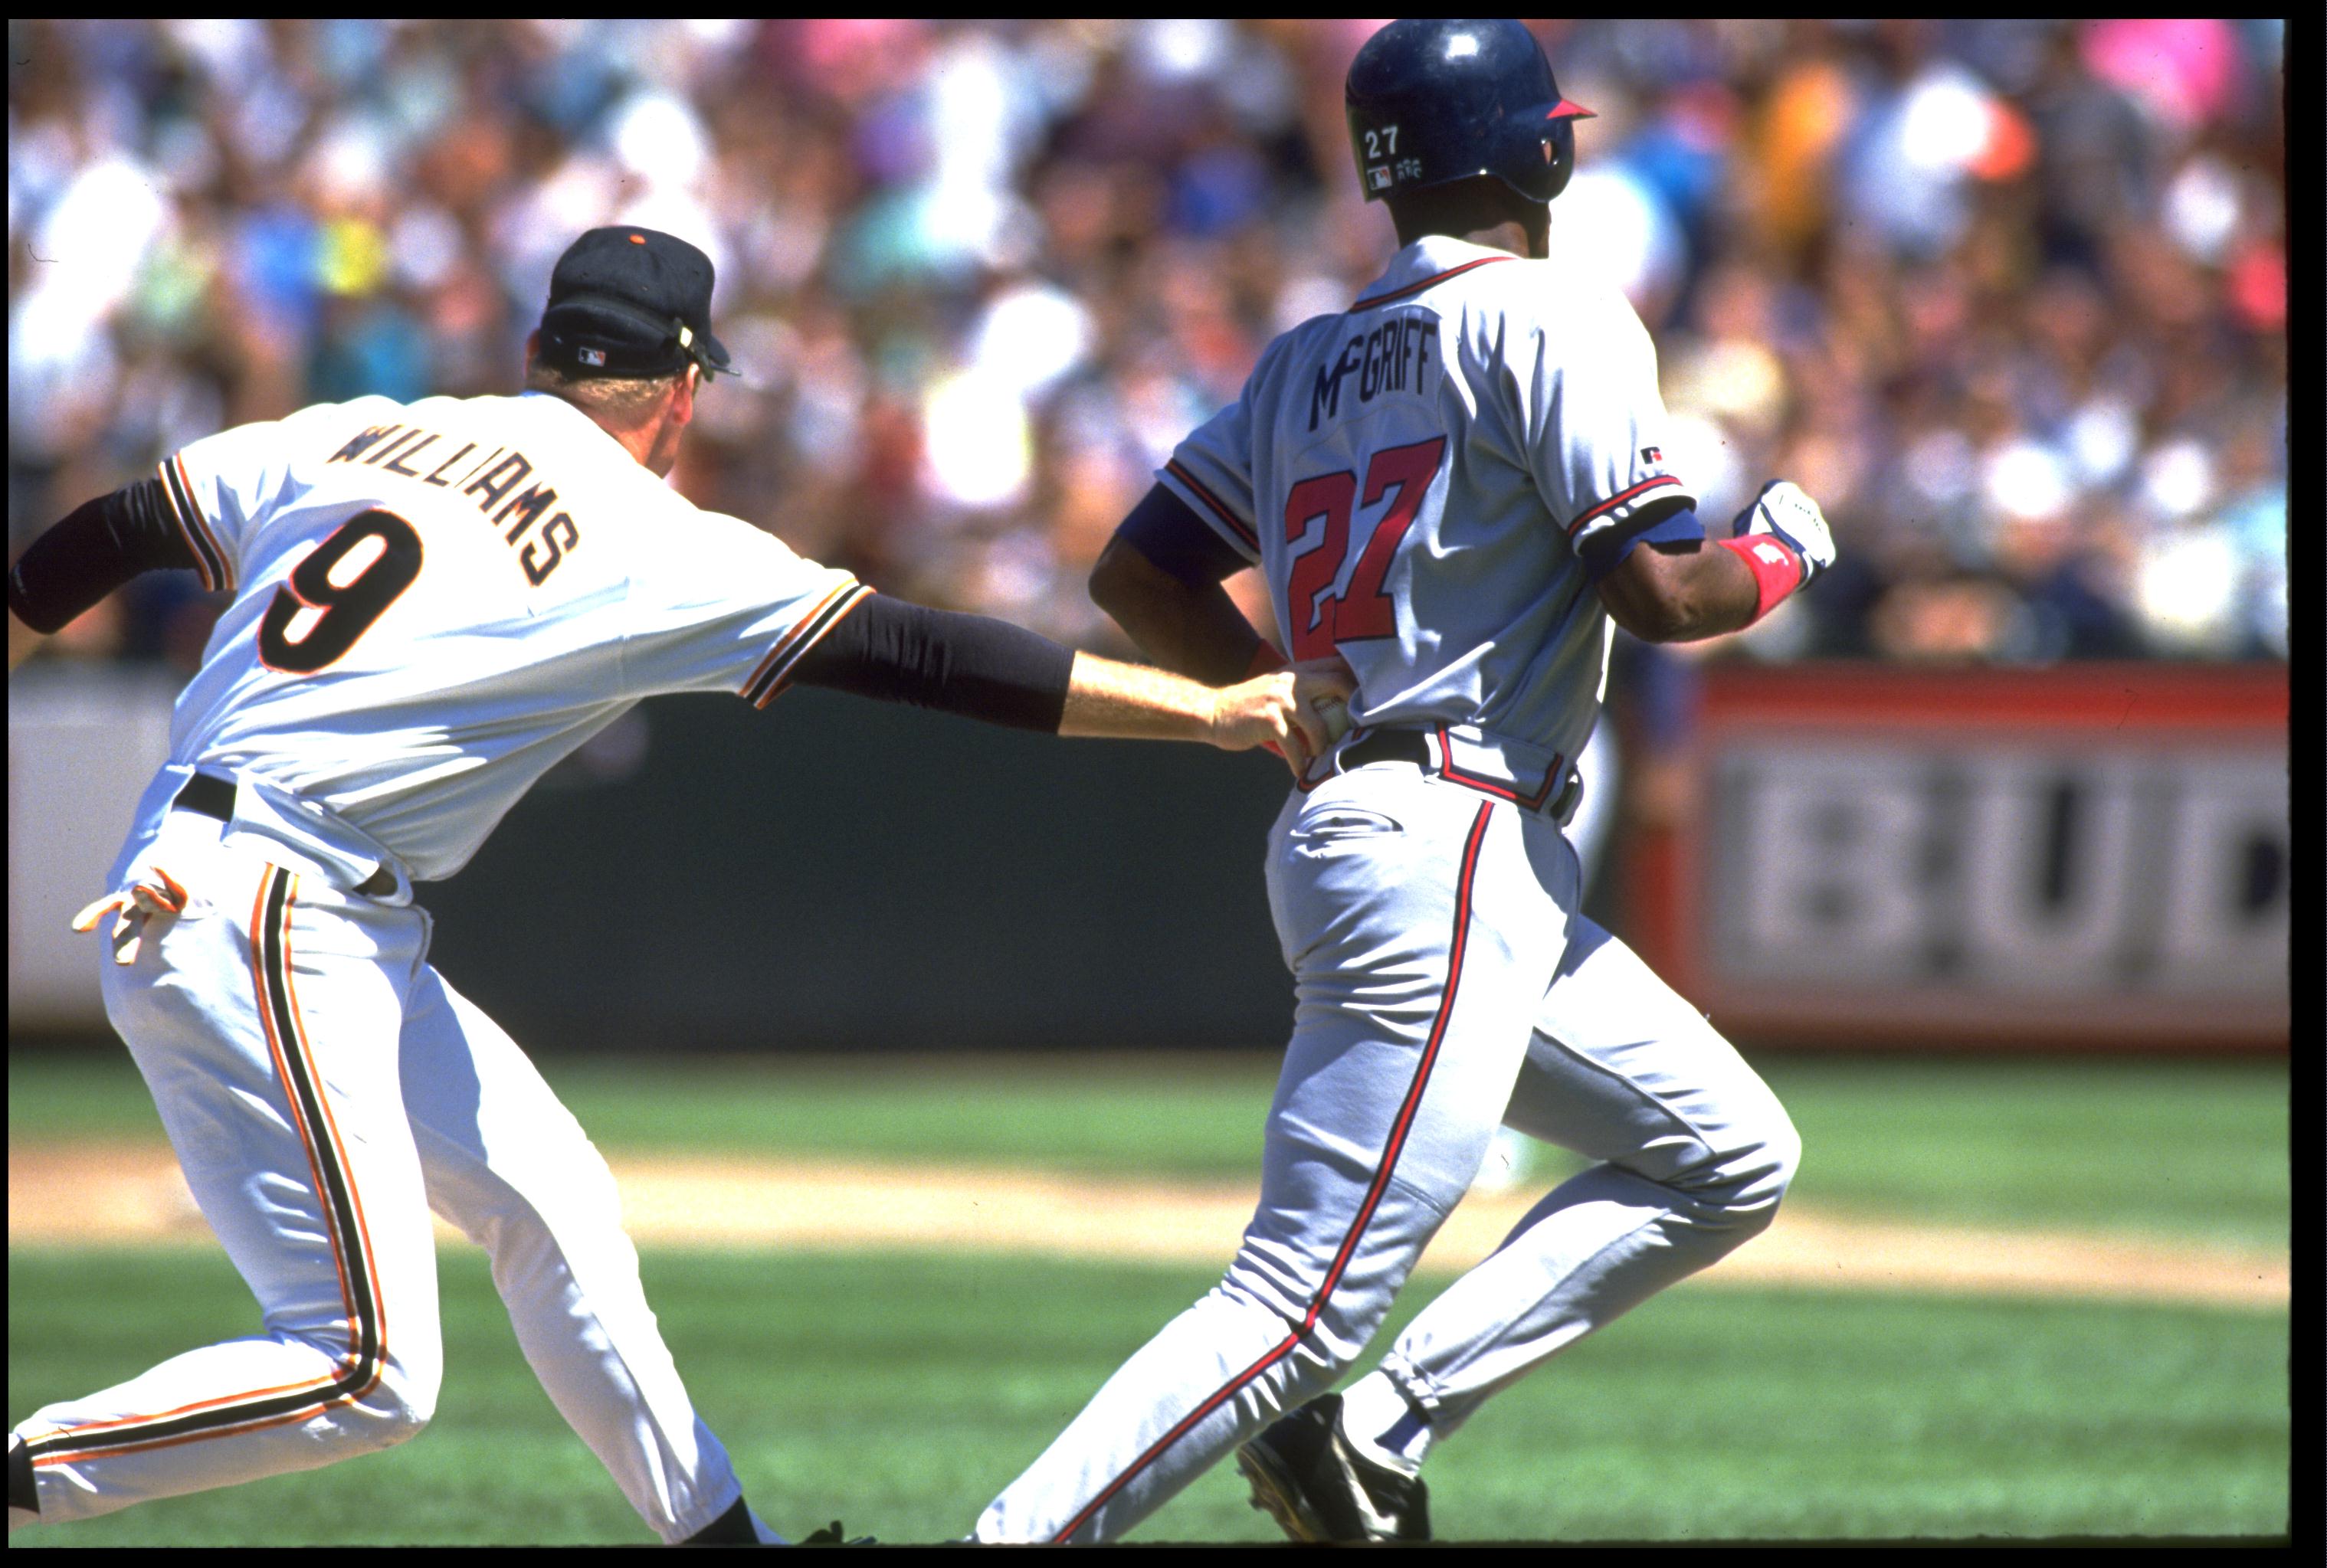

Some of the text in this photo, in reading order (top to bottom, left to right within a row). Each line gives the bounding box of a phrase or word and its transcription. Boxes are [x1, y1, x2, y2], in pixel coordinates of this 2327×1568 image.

[1365, 125, 1398, 159] 27
[257, 505, 424, 677] 9
[326, 424, 580, 588] WILLIAMS
[1285, 434, 1447, 663] 27
[1745, 768, 2289, 971] BUD
